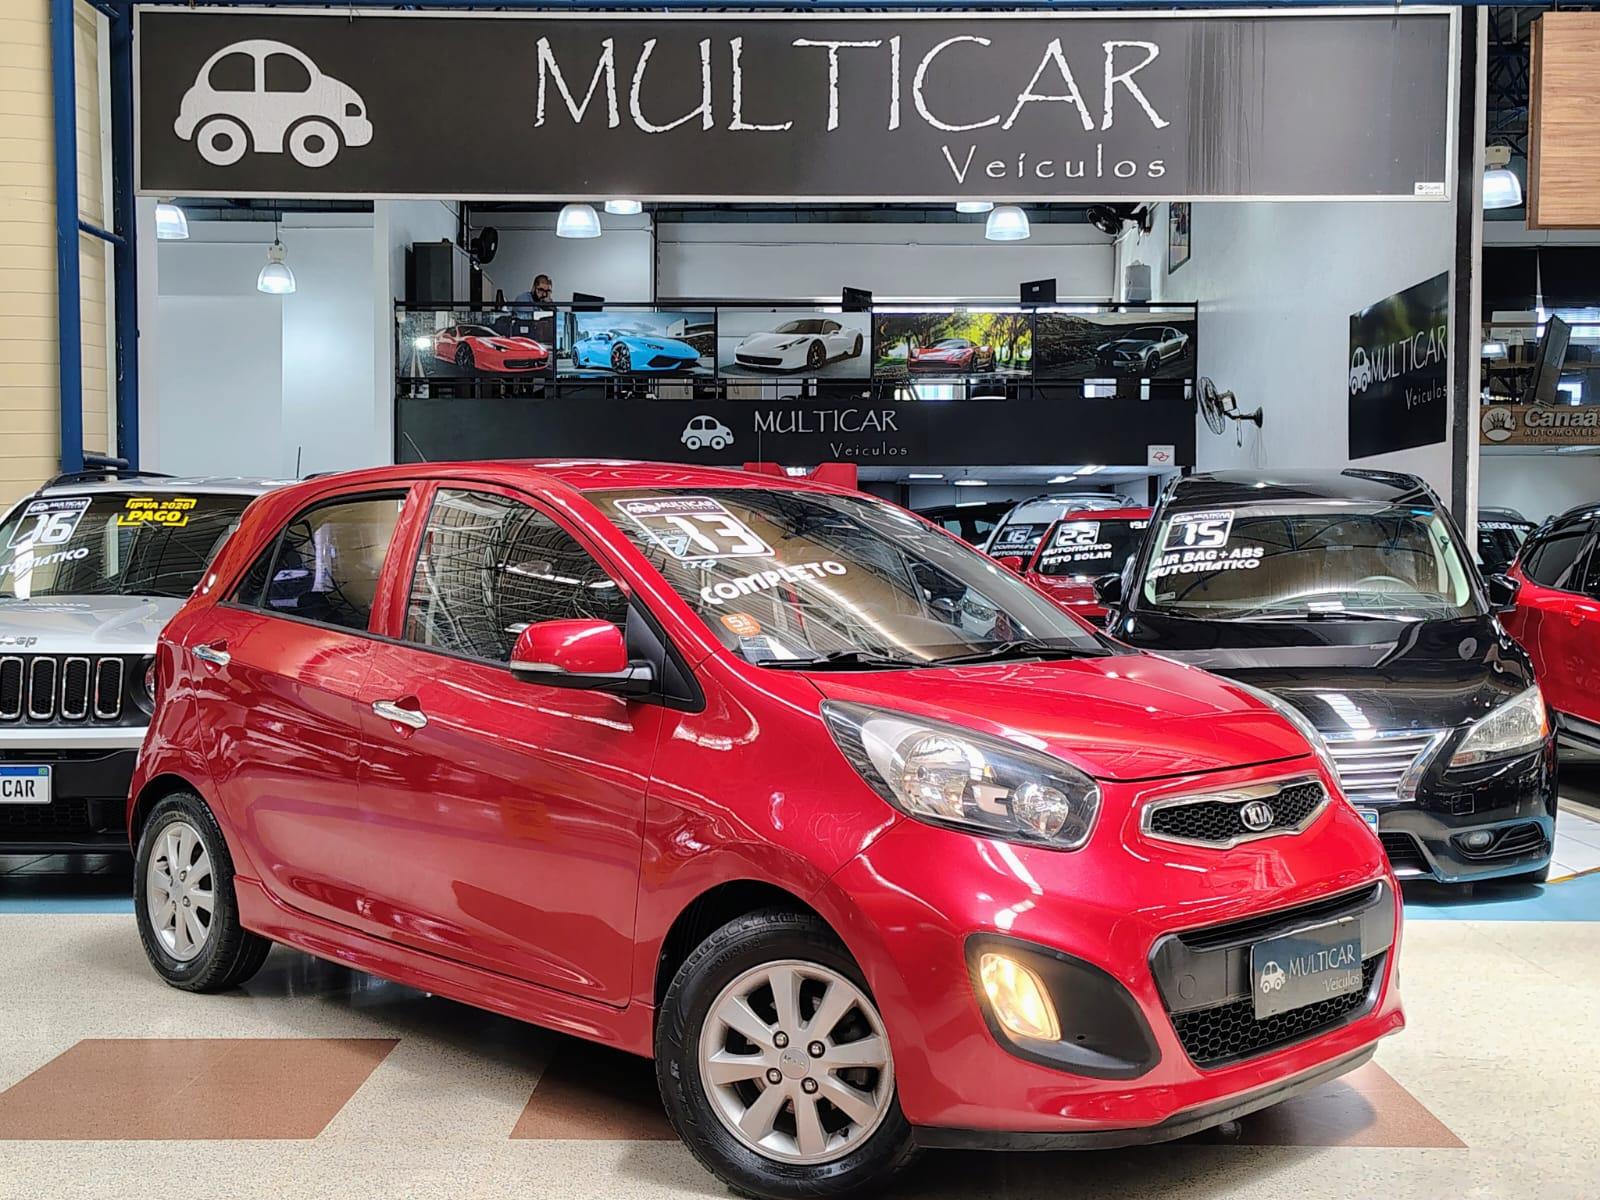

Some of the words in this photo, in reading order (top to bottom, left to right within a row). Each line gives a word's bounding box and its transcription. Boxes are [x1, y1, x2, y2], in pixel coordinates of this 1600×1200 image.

[533, 36, 1170, 132] MULTICAR
[942, 143, 1167, 184] Veículos
[1370, 325, 1448, 384] MULTICAR
[754, 409, 899, 433] MULTICAR
[1524, 407, 1598, 427] Canaã
[127, 510, 181, 521] PAGO
[32, 512, 77, 543] 16
[664, 514, 765, 554] 13
[1007, 530, 1027, 543] 16
[1059, 529, 1096, 545] 22
[1184, 521, 1225, 546] 15
[1042, 543, 1112, 556] AUTOMATICO
[1043, 554, 1072, 565] TETO
[1073, 551, 1112, 561] SOLAR
[1152, 553, 1181, 567] AIR
[1145, 559, 1260, 580] AUTOMATICO
[701, 560, 847, 605] COMPLETO
[2, 779, 35, 798] CAR
[1246, 805, 1271, 825] KIA
[1288, 944, 1356, 980] MULTICAR
